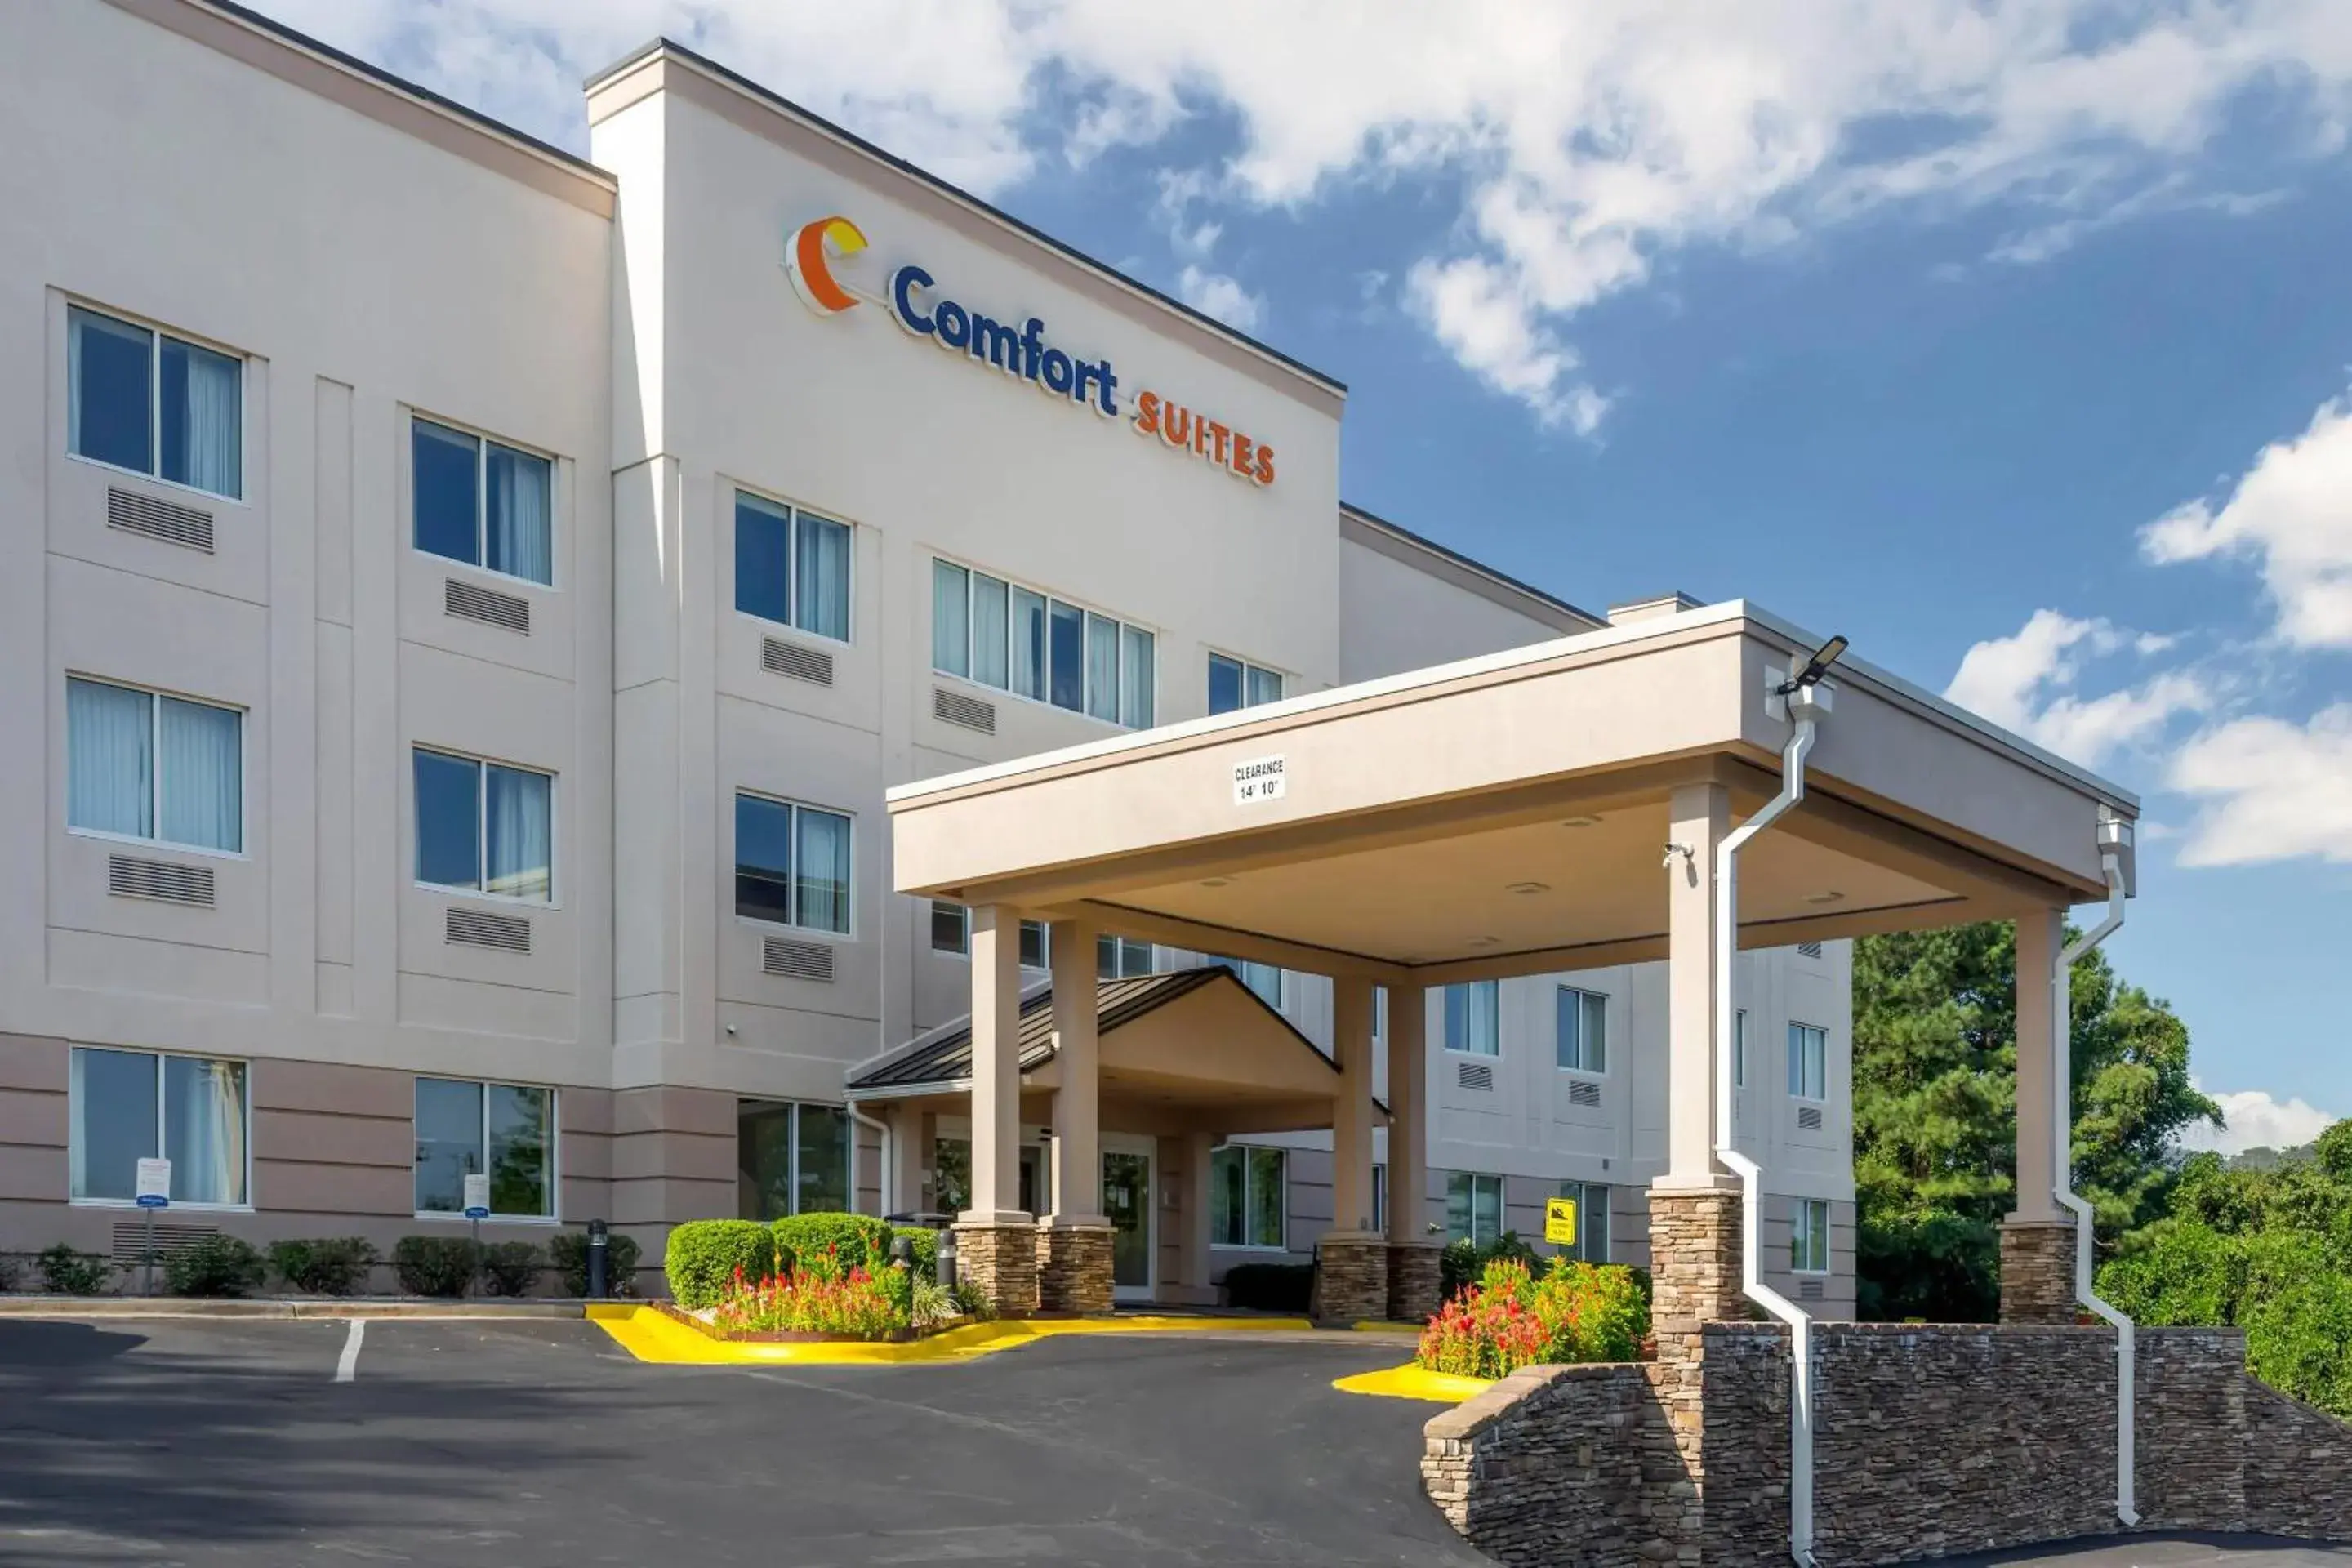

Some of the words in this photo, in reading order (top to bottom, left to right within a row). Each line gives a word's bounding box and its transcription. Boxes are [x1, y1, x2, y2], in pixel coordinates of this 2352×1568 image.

[889, 265, 1117, 416] Comfort
[1132, 390, 1275, 487] SUITES
[1235, 760, 1283, 782] CLEARANCE
